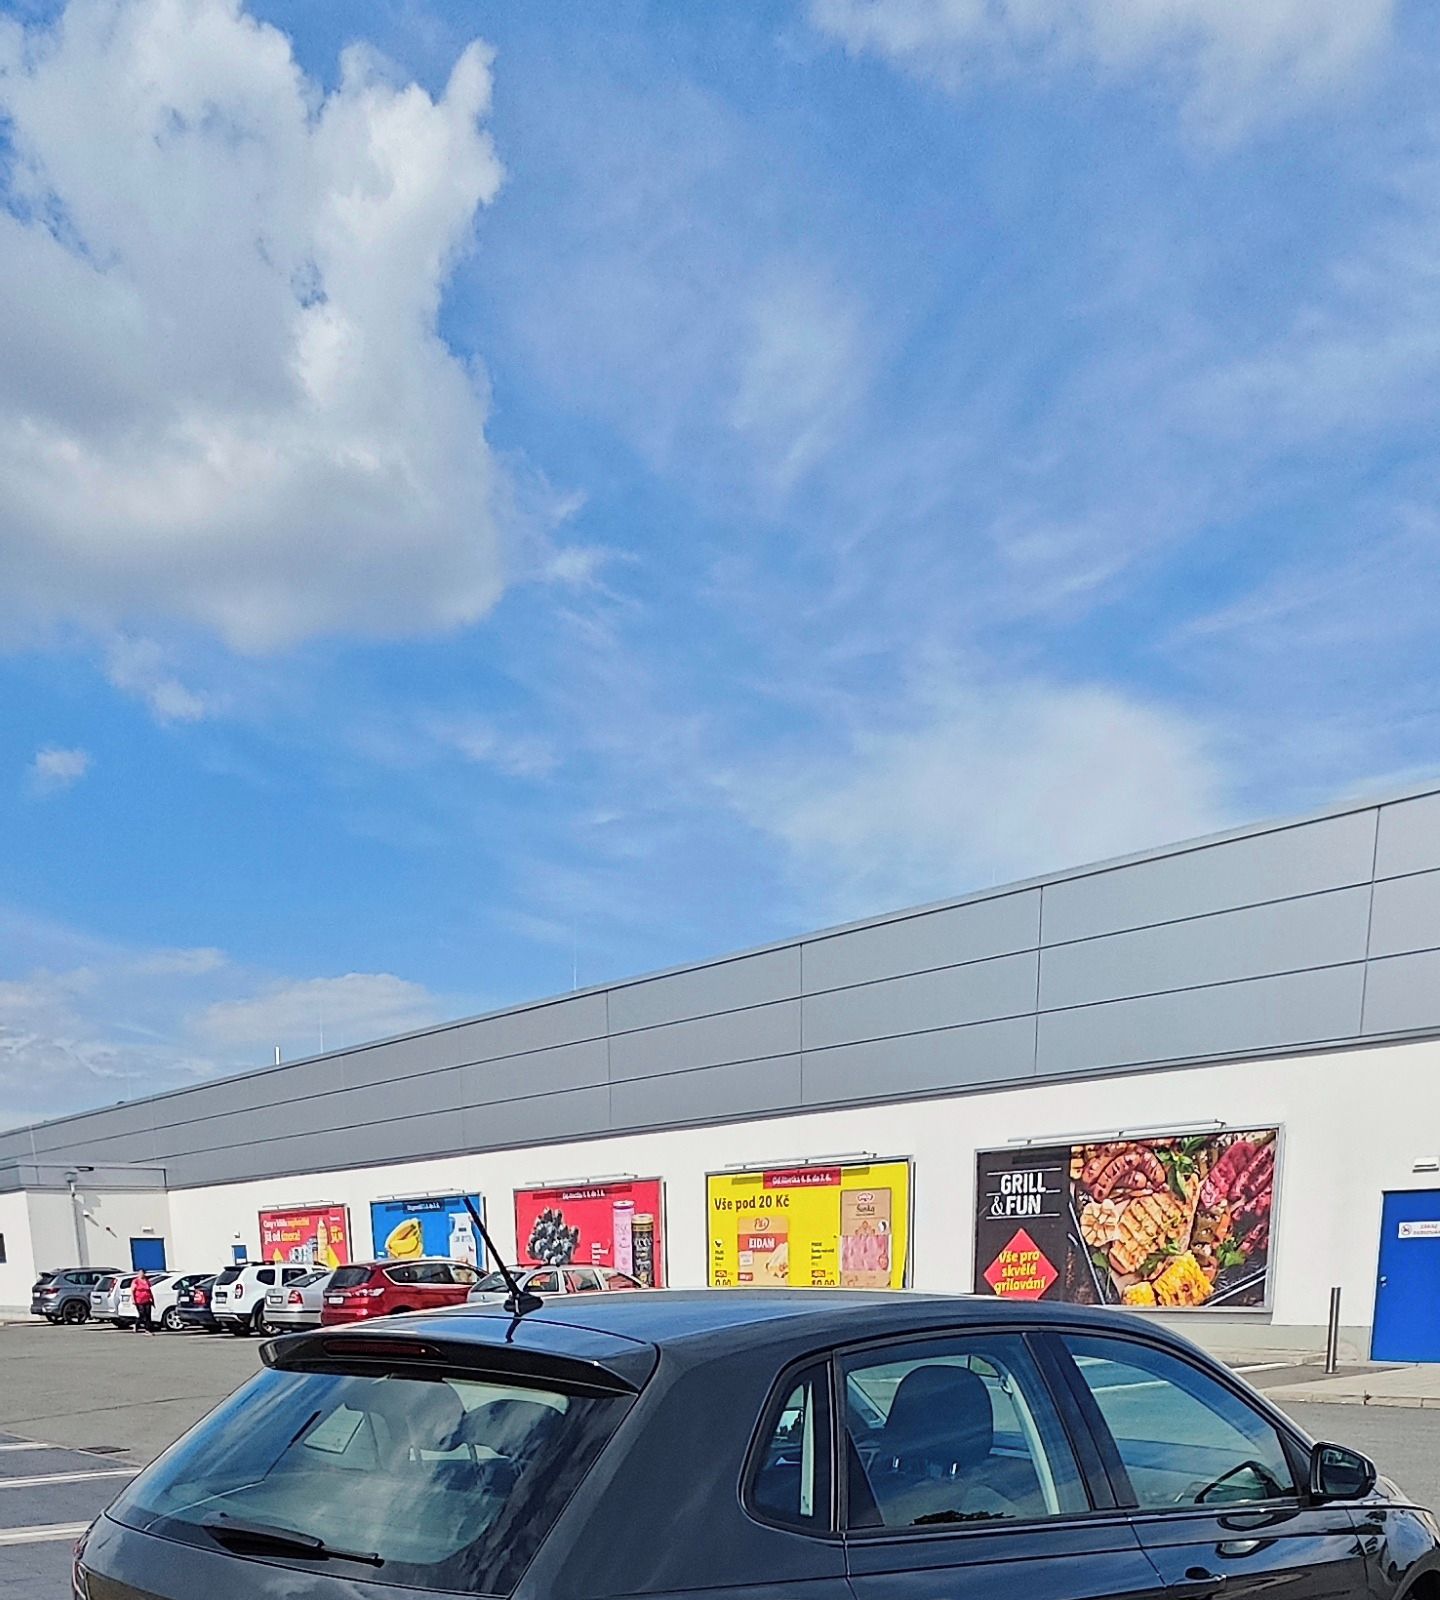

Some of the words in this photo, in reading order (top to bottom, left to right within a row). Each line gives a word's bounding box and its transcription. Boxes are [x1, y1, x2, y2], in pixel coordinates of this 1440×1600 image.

[1001, 1172, 1046, 1194] GRILL
[714, 1198, 732, 1210] Vše
[736, 1196, 755, 1212] pod
[759, 1195, 772, 1208] 20
[776, 1194, 790, 1207] Kč
[749, 1237, 775, 1248] EIDAM
[999, 1251, 1018, 1263] Vše
[1020, 1251, 1040, 1264] pro
[1002, 1262, 1037, 1277] skvělé
[994, 1276, 1046, 1296] grilování
